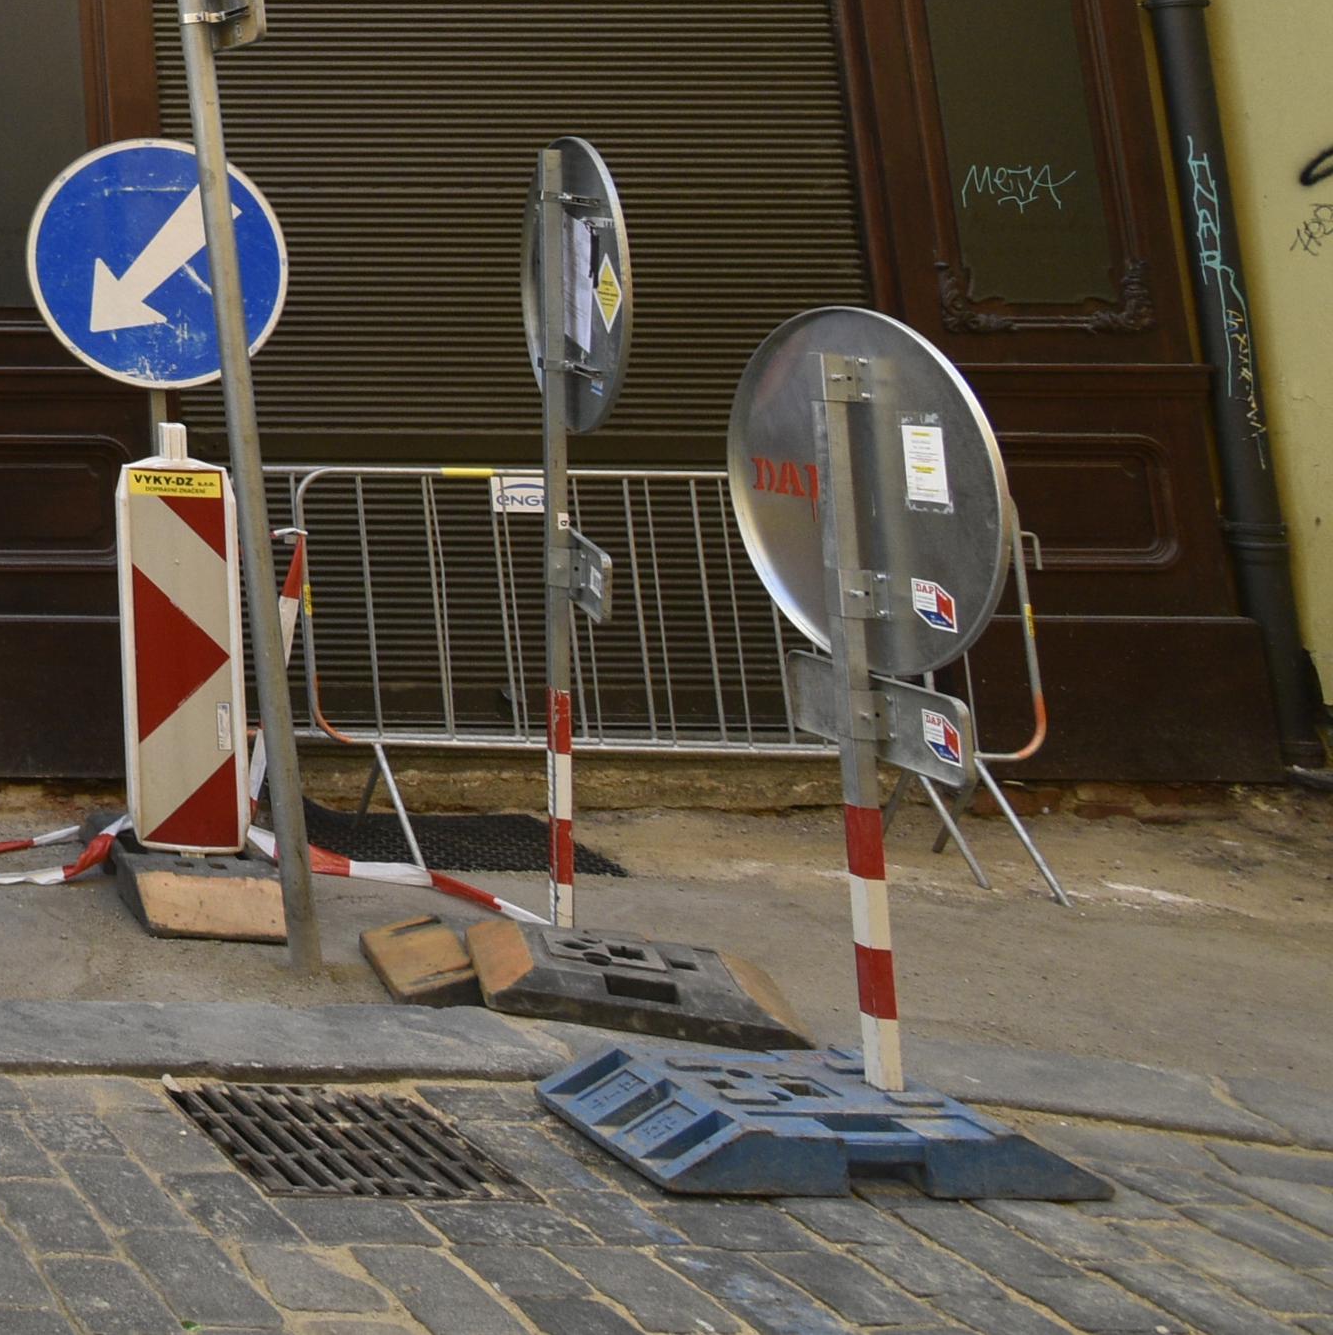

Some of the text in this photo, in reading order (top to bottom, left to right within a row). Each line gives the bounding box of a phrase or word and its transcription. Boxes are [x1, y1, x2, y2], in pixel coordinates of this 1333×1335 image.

[134, 474, 193, 486] VYKY-DZ
[916, 582, 935, 595] DAP
[925, 714, 942, 726] DAP
